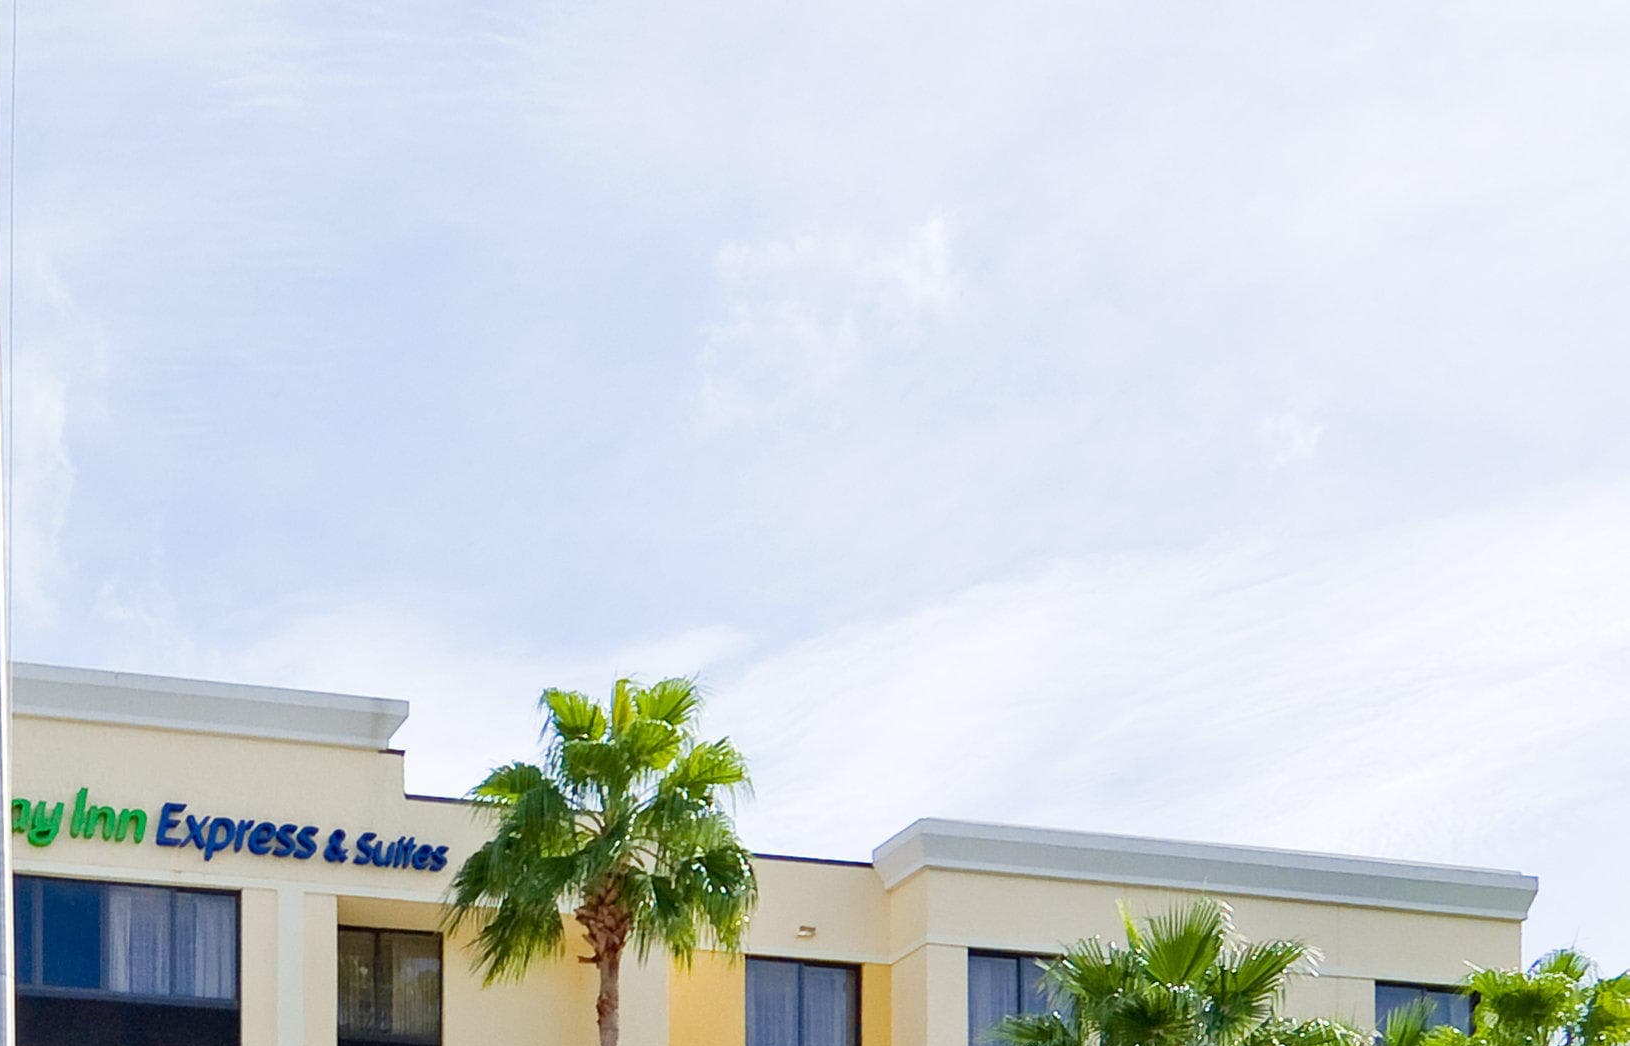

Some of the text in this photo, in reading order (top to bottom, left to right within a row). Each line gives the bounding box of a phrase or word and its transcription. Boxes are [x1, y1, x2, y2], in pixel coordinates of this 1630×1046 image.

[69, 787, 148, 845] Inn
[155, 802, 319, 861] Express
[323, 829, 348, 863] &
[353, 832, 449, 872] Suites
